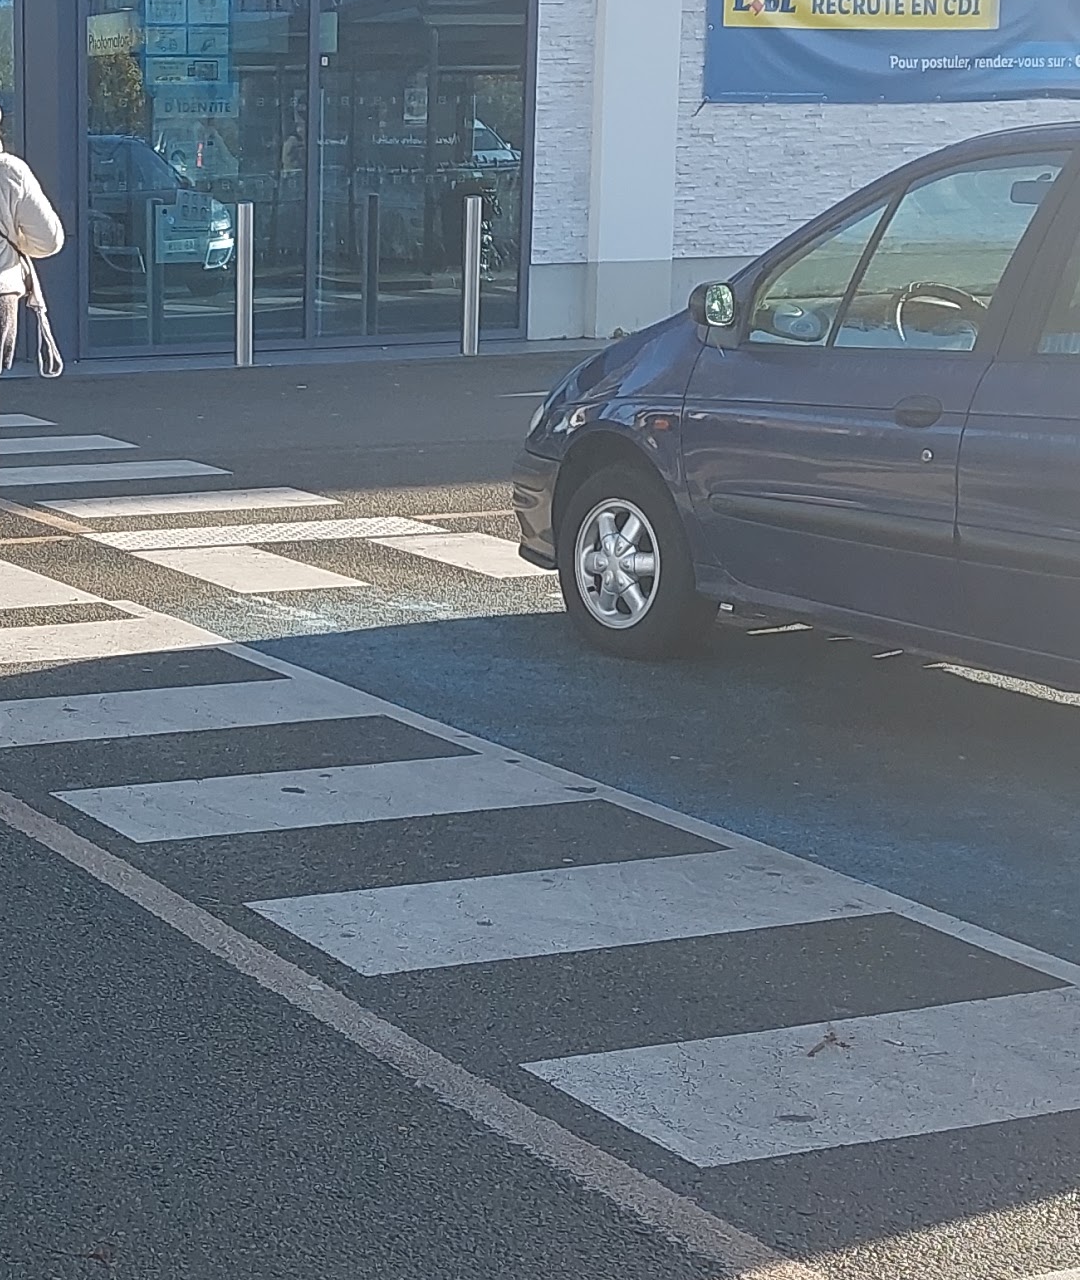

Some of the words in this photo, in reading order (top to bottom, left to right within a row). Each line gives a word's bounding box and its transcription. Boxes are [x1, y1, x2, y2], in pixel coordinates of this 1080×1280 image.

[889, 55, 919, 69] Pour
[921, 55, 972, 72] postuler,
[975, 54, 1045, 69] rendez-vous
[1047, 56, 1067, 69] sur
